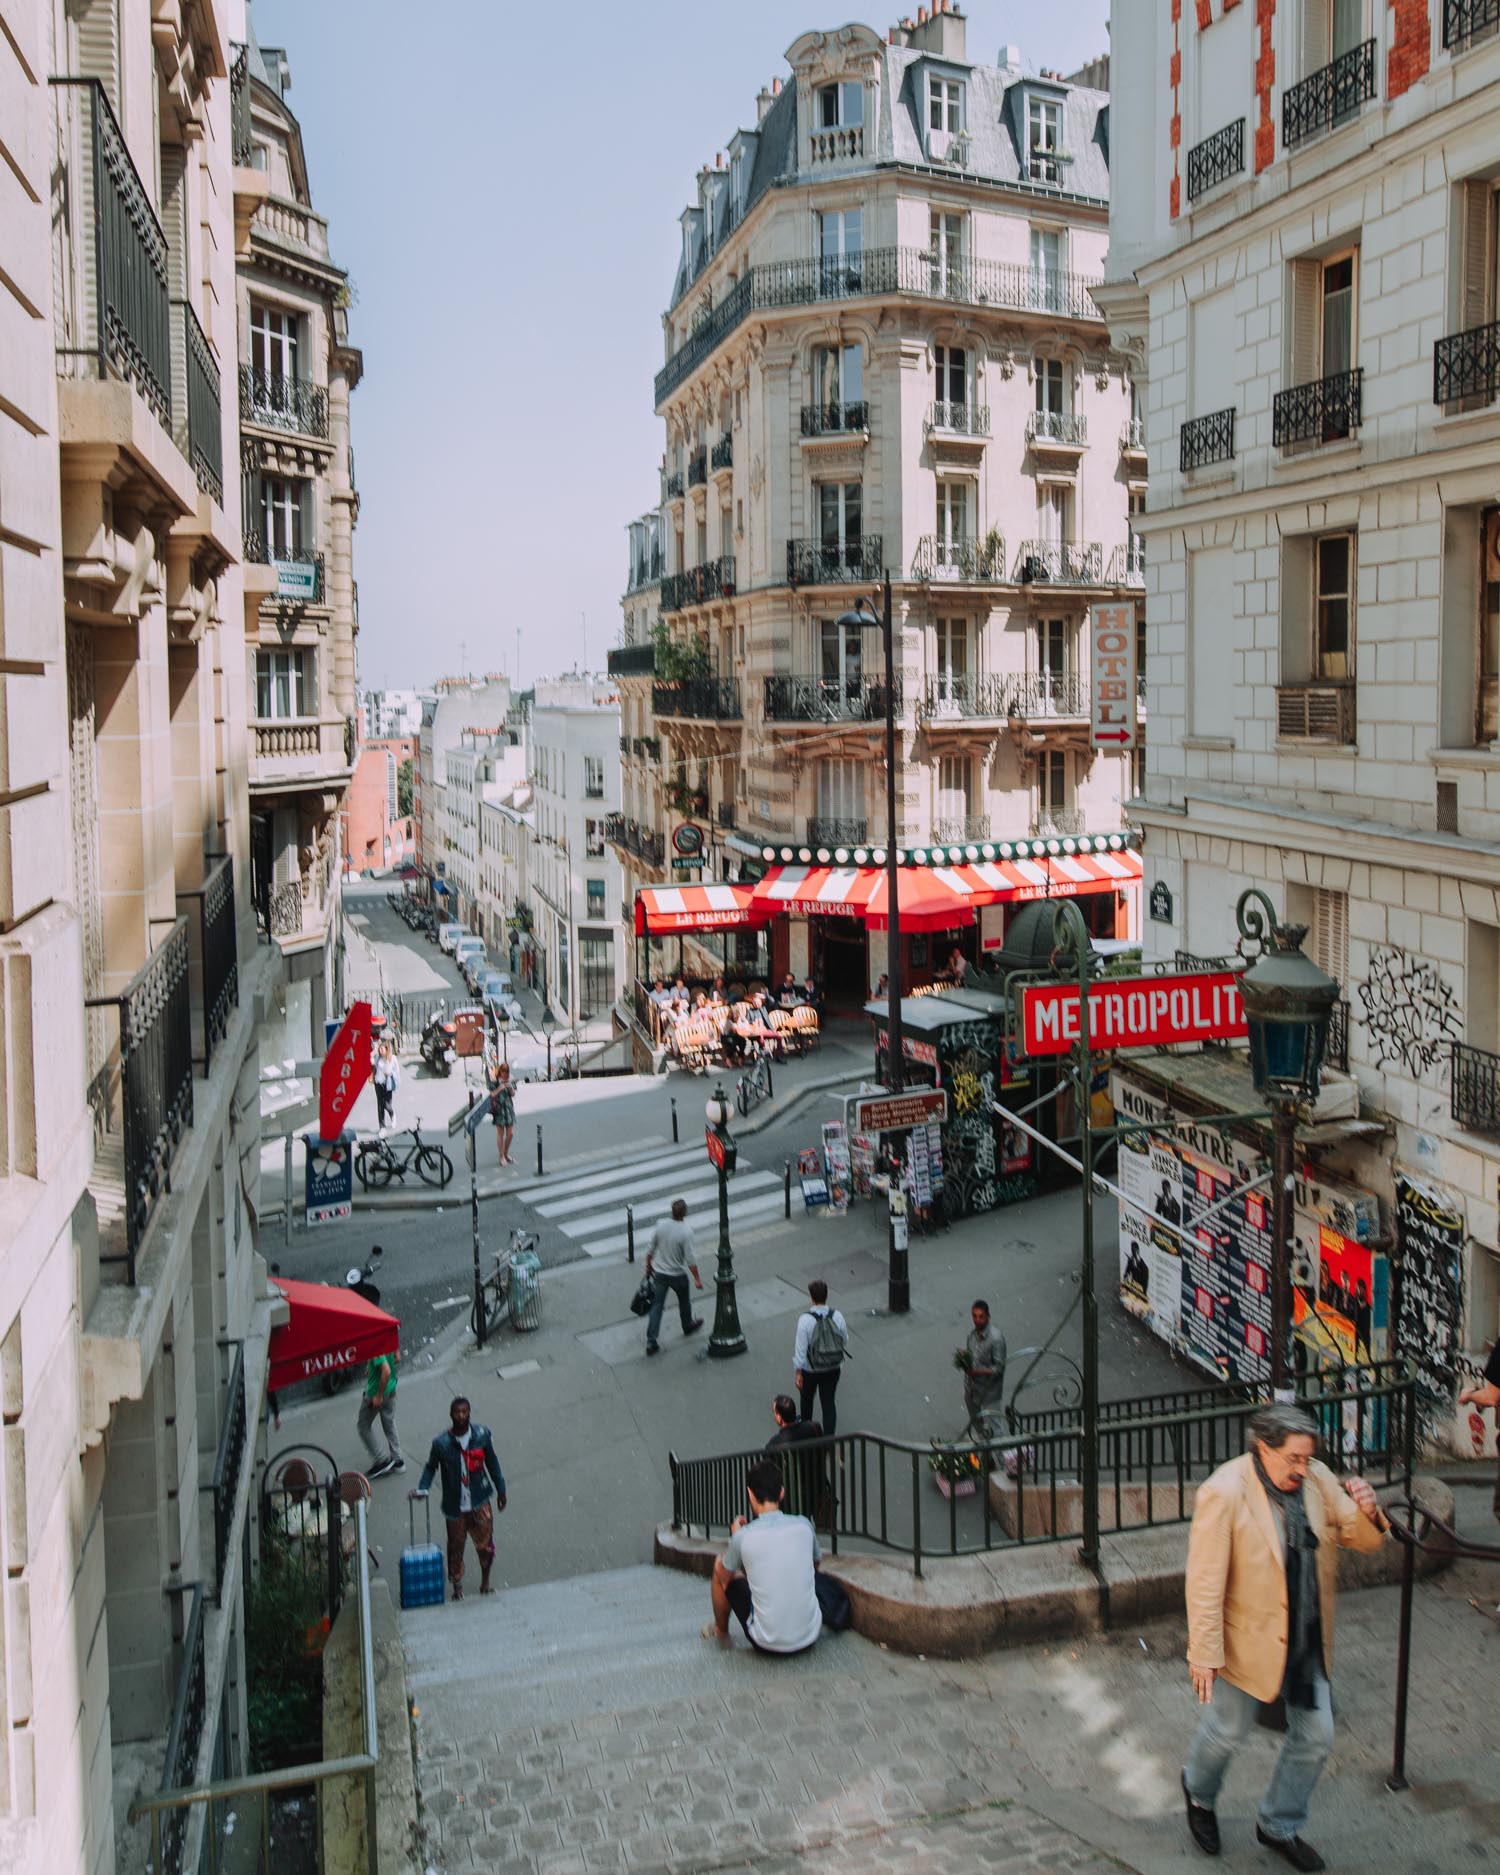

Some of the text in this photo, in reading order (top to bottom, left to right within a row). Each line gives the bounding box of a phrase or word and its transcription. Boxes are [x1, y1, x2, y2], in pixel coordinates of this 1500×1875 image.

[1095, 607, 1129, 724] HOTEL
[675, 909, 749, 925] LE REFUGE
[783, 900, 855, 915] LE REFUGE
[1034, 985, 1247, 1042] METROPOLIT
[332, 1029, 361, 1112] TABAC
[1151, 1161, 1183, 1184] STAPLES
[1153, 1150, 1179, 1171] VINCE
[1120, 1221, 1150, 1247] STAPLES
[1124, 1212, 1147, 1232] VINCE
[302, 1346, 357, 1376] TABAC
